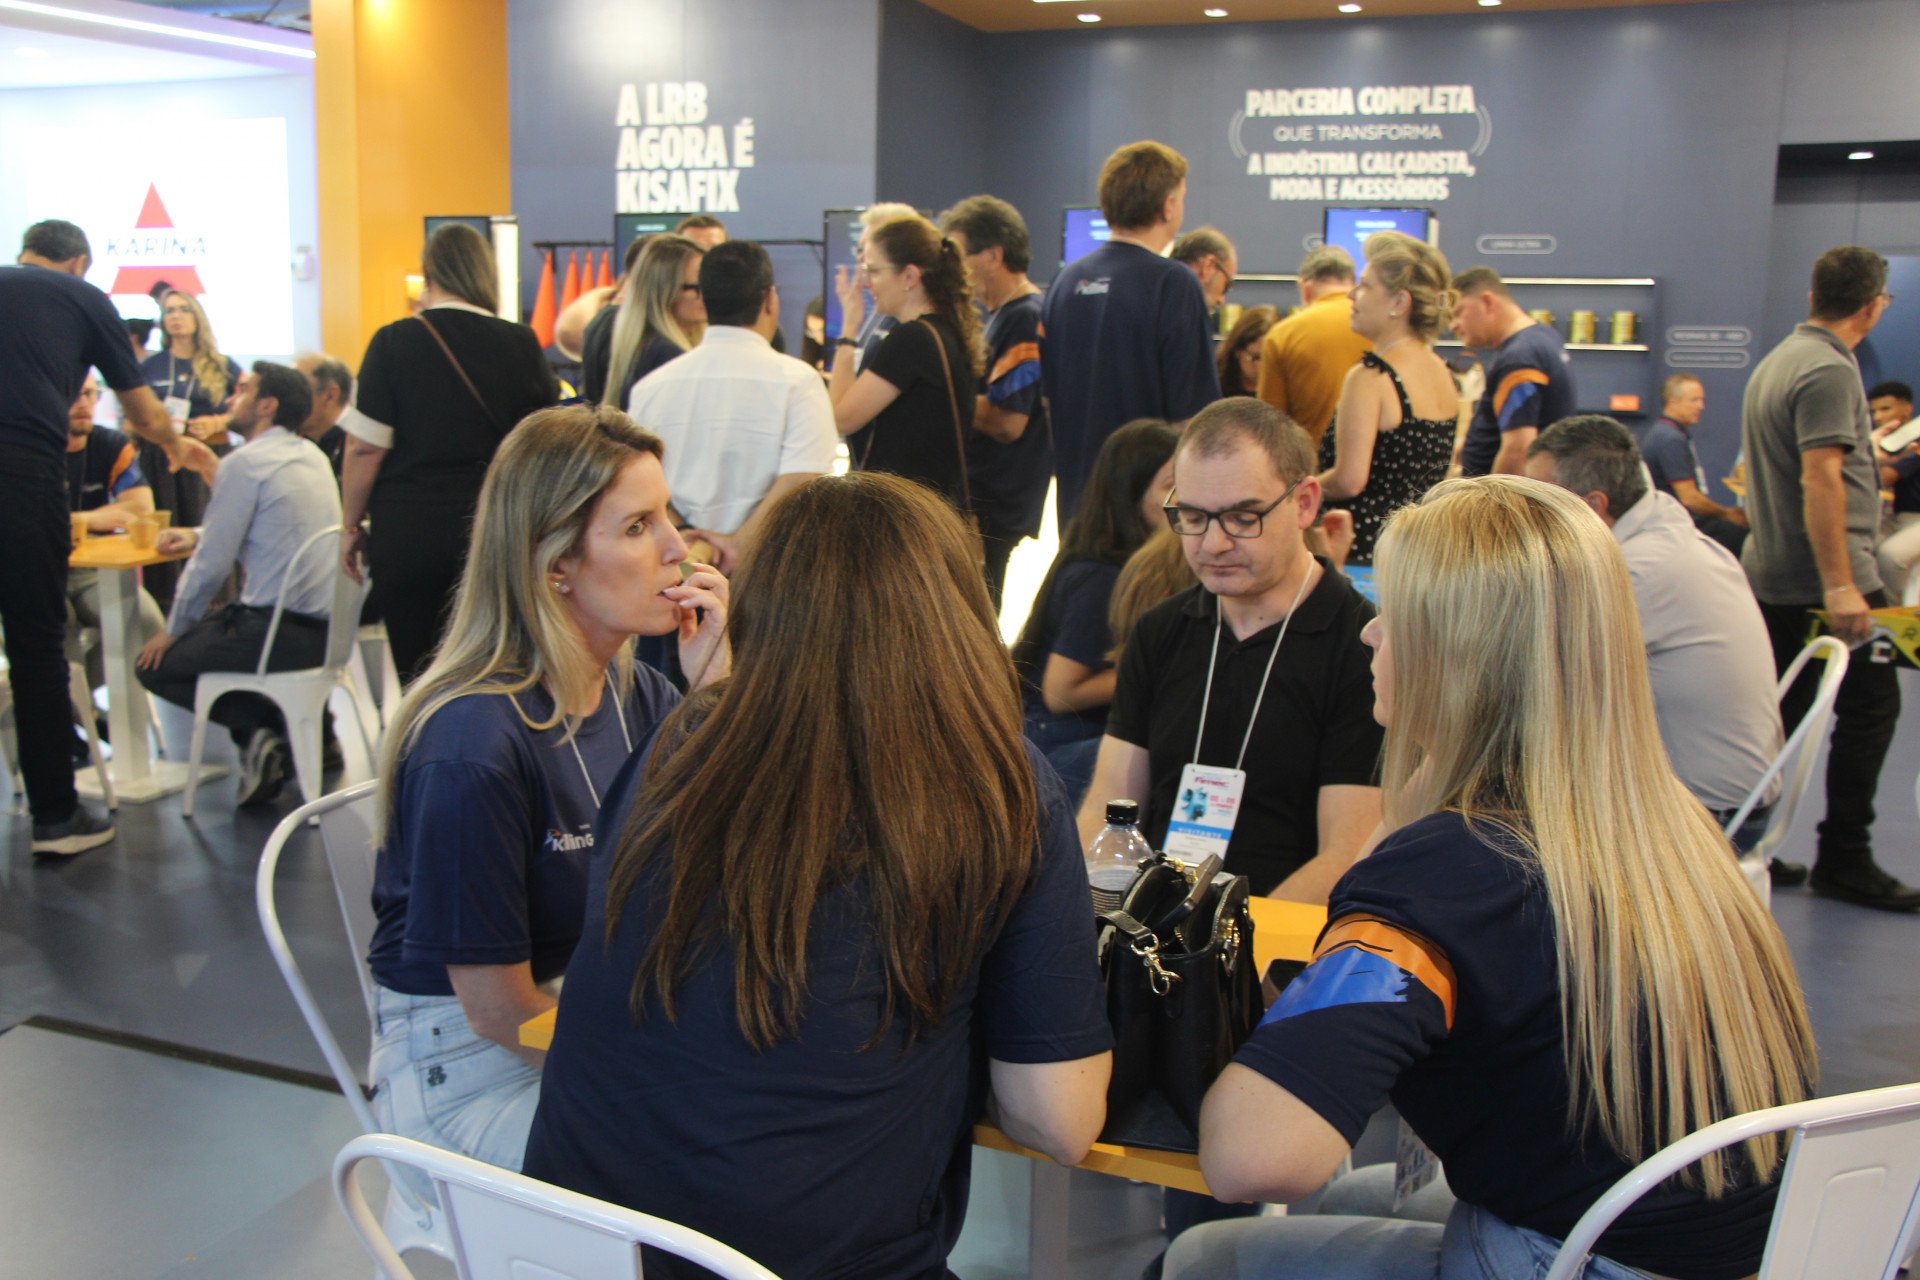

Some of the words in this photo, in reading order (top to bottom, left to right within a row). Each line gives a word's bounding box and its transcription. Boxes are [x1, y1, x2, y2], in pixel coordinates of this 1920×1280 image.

[615, 83, 642, 127] A
[646, 81, 708, 126] LRB
[1246, 87, 1355, 117] PARCERIA
[1358, 85, 1476, 115] COMPLETA
[615, 125, 729, 170] AGORA
[733, 116, 755, 168] É
[1273, 125, 1313, 142] QUE
[1318, 124, 1443, 142] TRANSFORMA
[1246, 152, 1262, 175] A
[1264, 148, 1359, 175] INDÚSTRIA
[1361, 150, 1476, 178] CALÇADISTA,
[615, 169, 741, 213] KISAFIX
[1269, 177, 1324, 200] MODA
[1325, 177, 1338, 200] E
[1339, 175, 1450, 200] ACESSÓRIOS
[107, 237, 206, 256] KARINA
